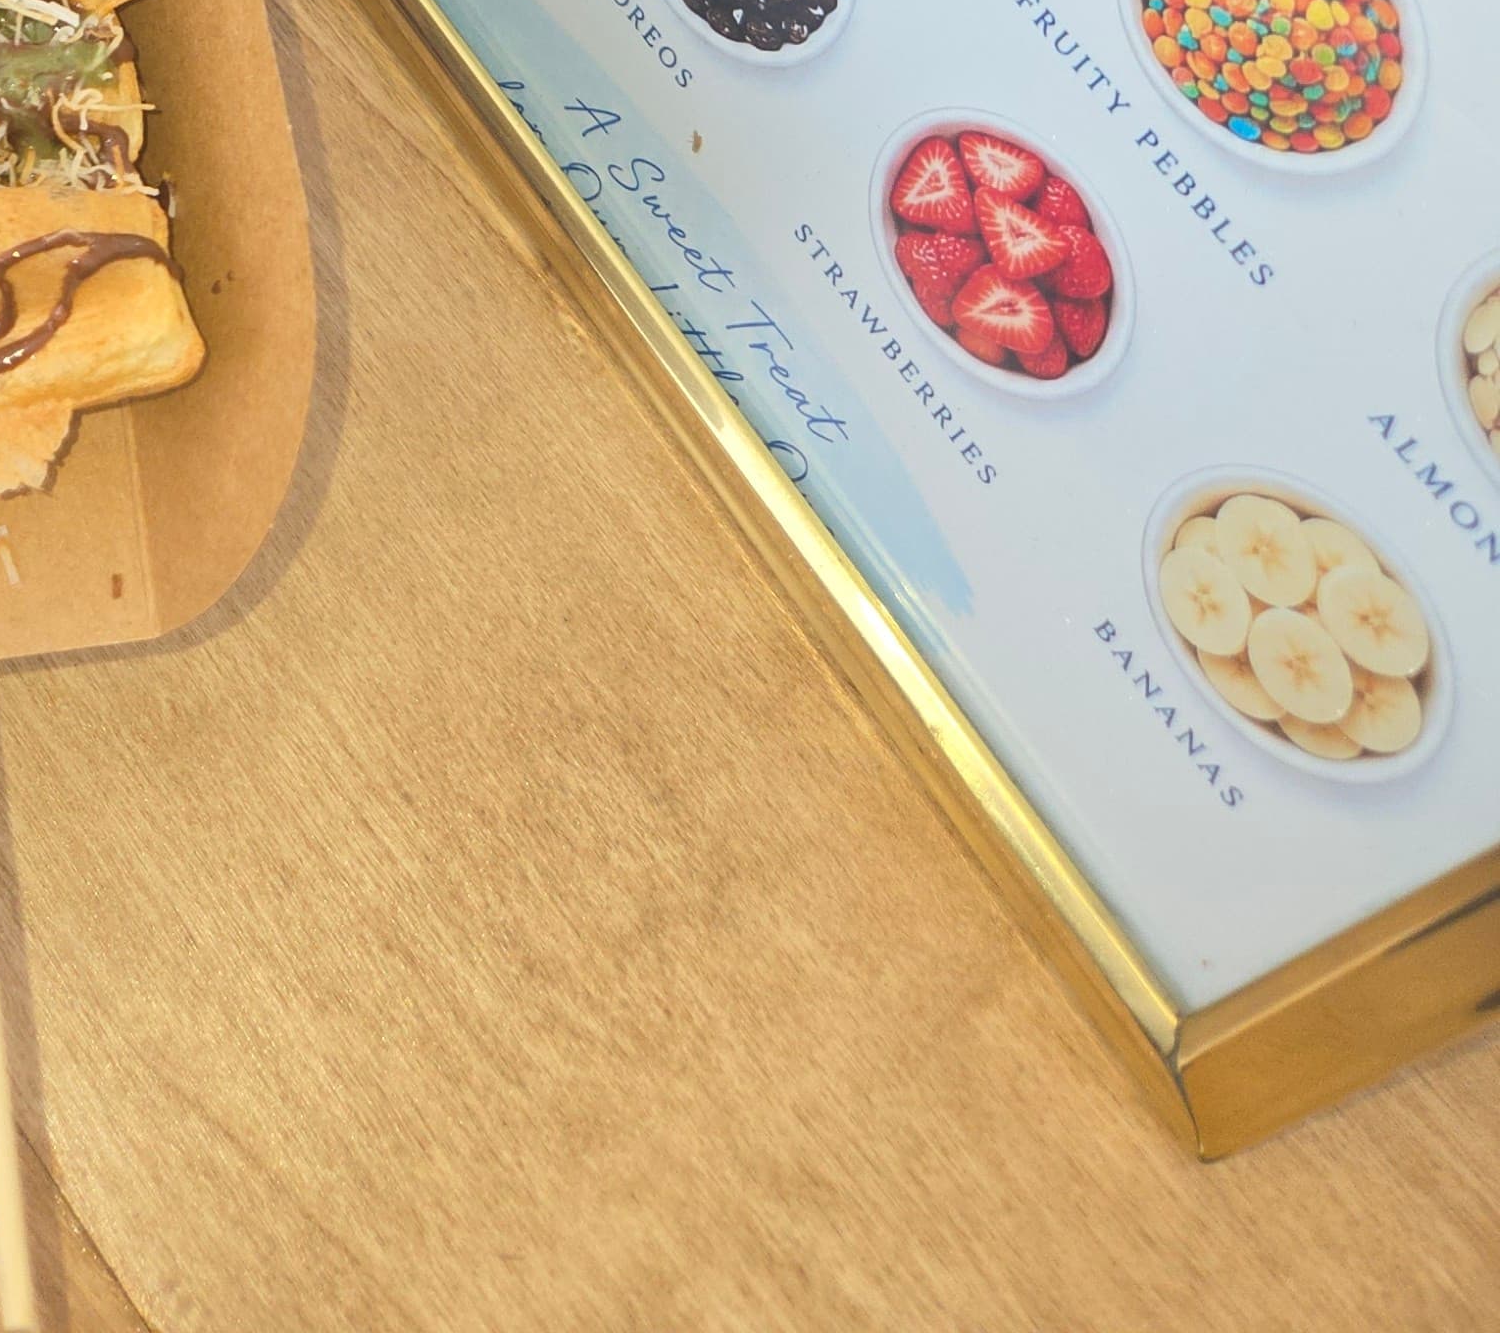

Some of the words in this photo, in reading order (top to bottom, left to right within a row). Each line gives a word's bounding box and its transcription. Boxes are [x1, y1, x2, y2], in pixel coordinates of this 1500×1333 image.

[563, 97, 622, 138] A
[607, 156, 737, 295] Sweet
[725, 299, 849, 444] Treat
[1134, 127, 1275, 286] PEBBLES
[794, 224, 997, 485] STRAWBERRIES
[1093, 618, 1244, 808] BANANAS
